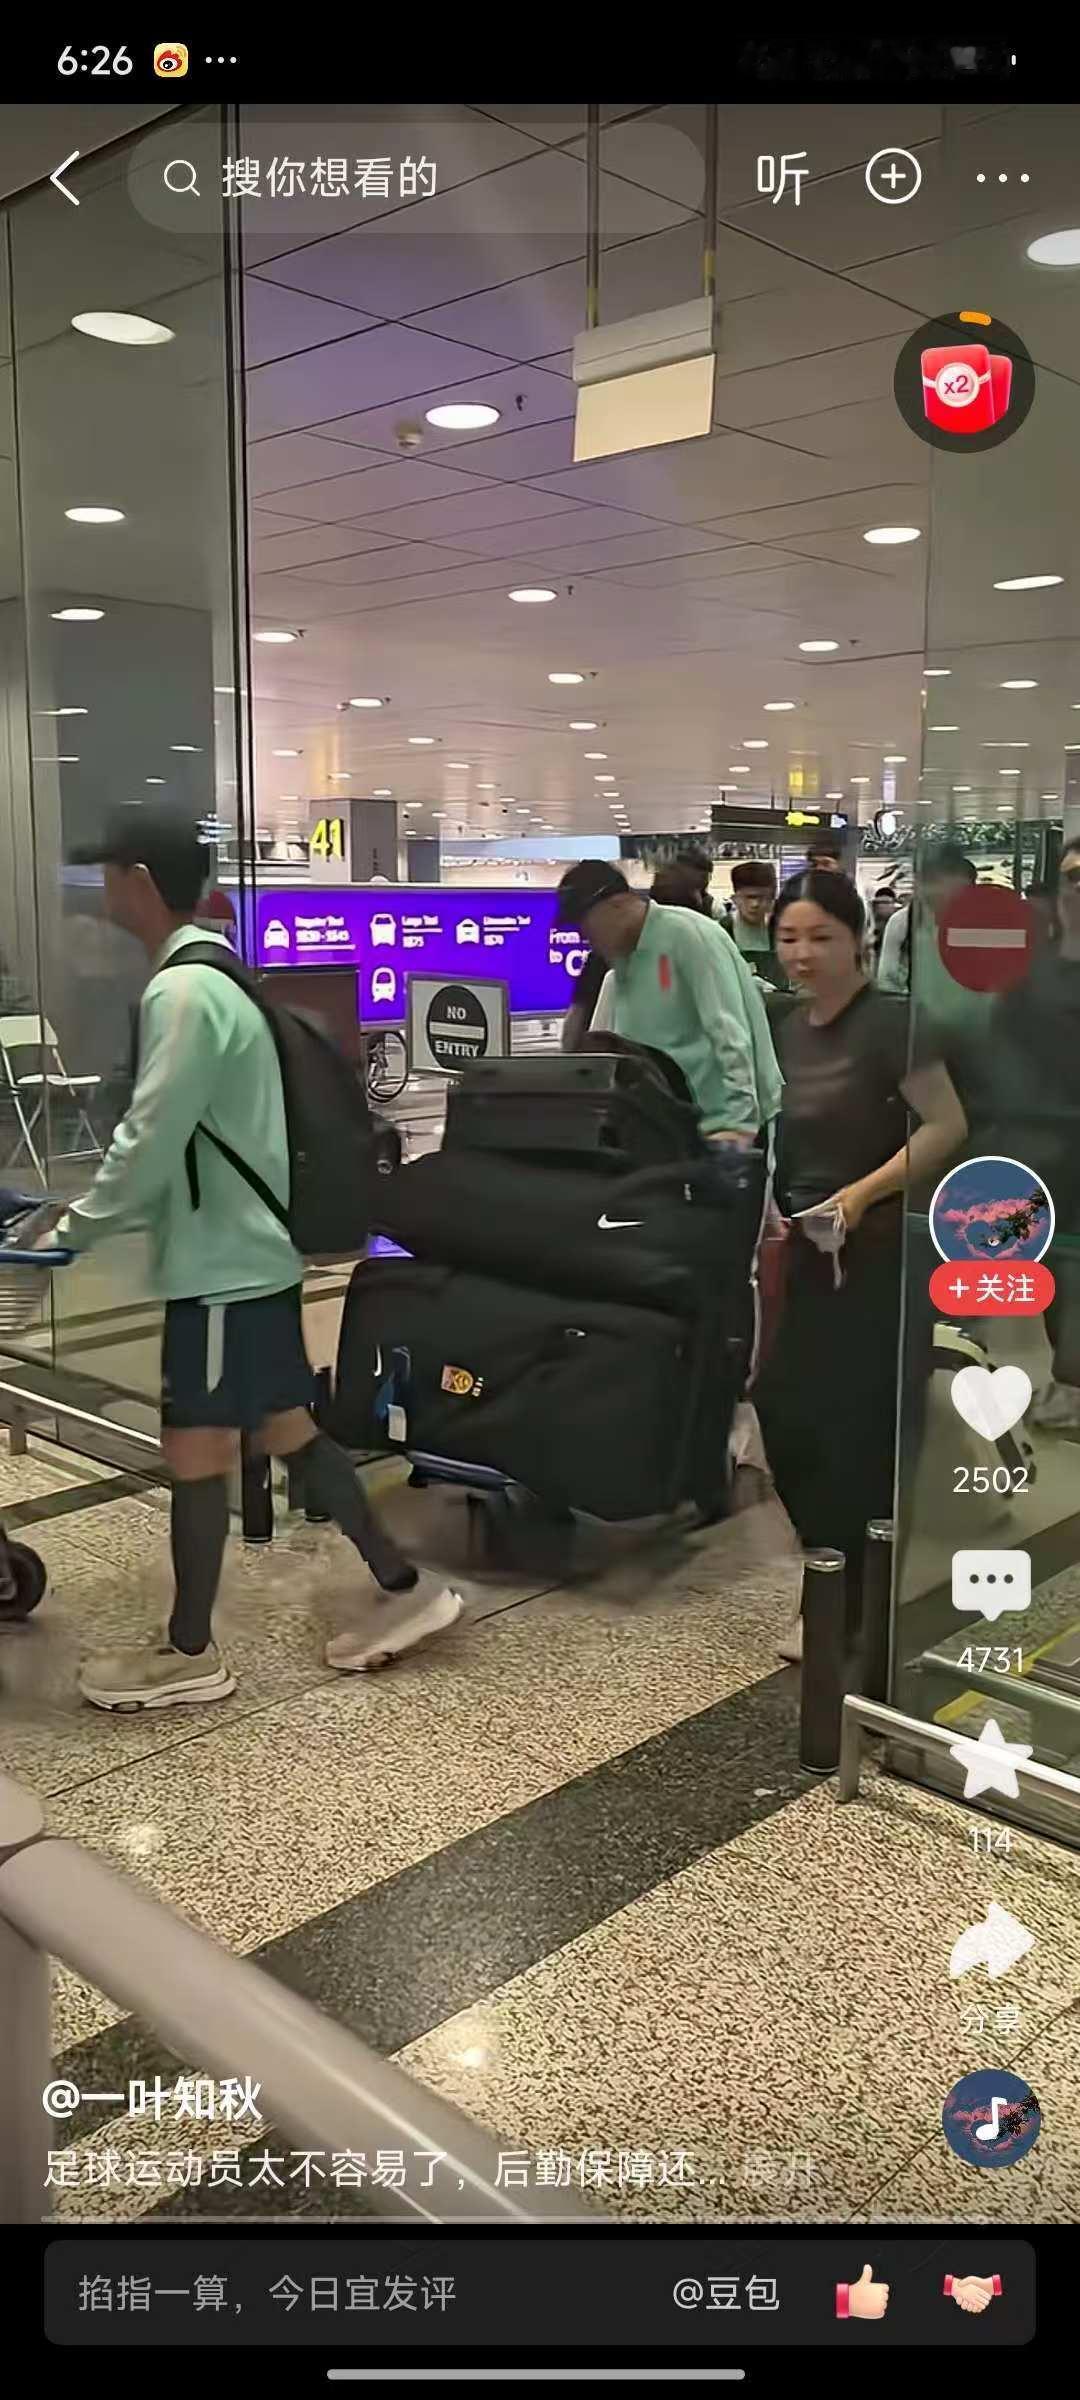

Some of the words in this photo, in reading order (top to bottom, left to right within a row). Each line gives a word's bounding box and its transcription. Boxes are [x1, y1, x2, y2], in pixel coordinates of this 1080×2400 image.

[309, 817, 342, 860] 41
[447, 1006, 466, 1020] NO
[435, 1040, 479, 1057] ENTRY
